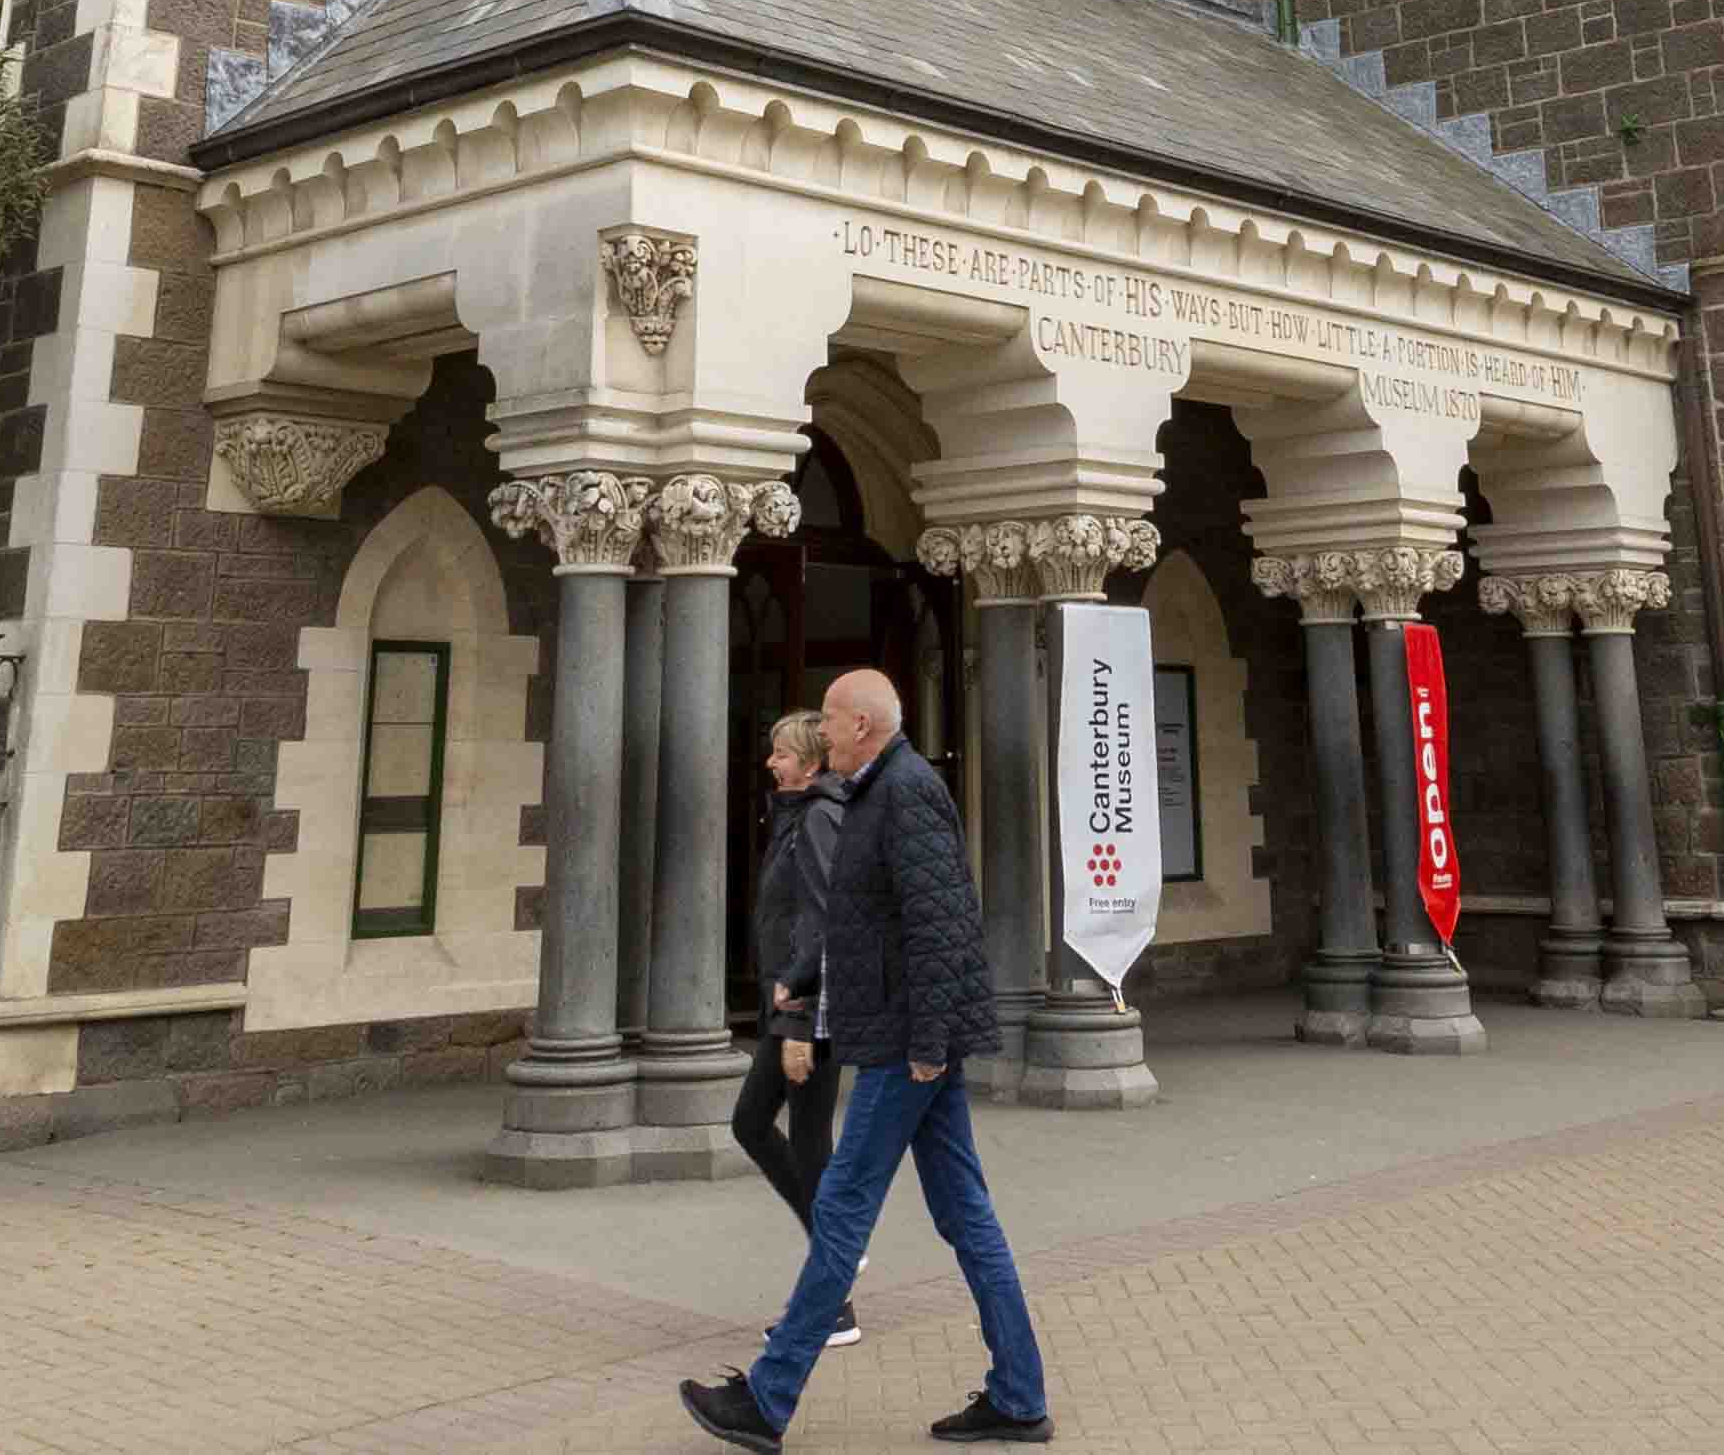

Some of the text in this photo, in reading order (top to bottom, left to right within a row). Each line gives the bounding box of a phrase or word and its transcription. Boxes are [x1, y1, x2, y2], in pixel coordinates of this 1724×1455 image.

[843, 221, 1582, 402] LO THESE ARE PARTS OF HIS WAYS BUT HOW LITTLE A PORTION IS HEARD OF HIM
[1037, 316, 1187, 375] CANTERBURY
[1362, 372, 1478, 421] MUSEUM 1870
[1089, 658, 1113, 834] Canterbury
[1115, 703, 1134, 834] Museum
[1089, 897, 1137, 909] Free entry
